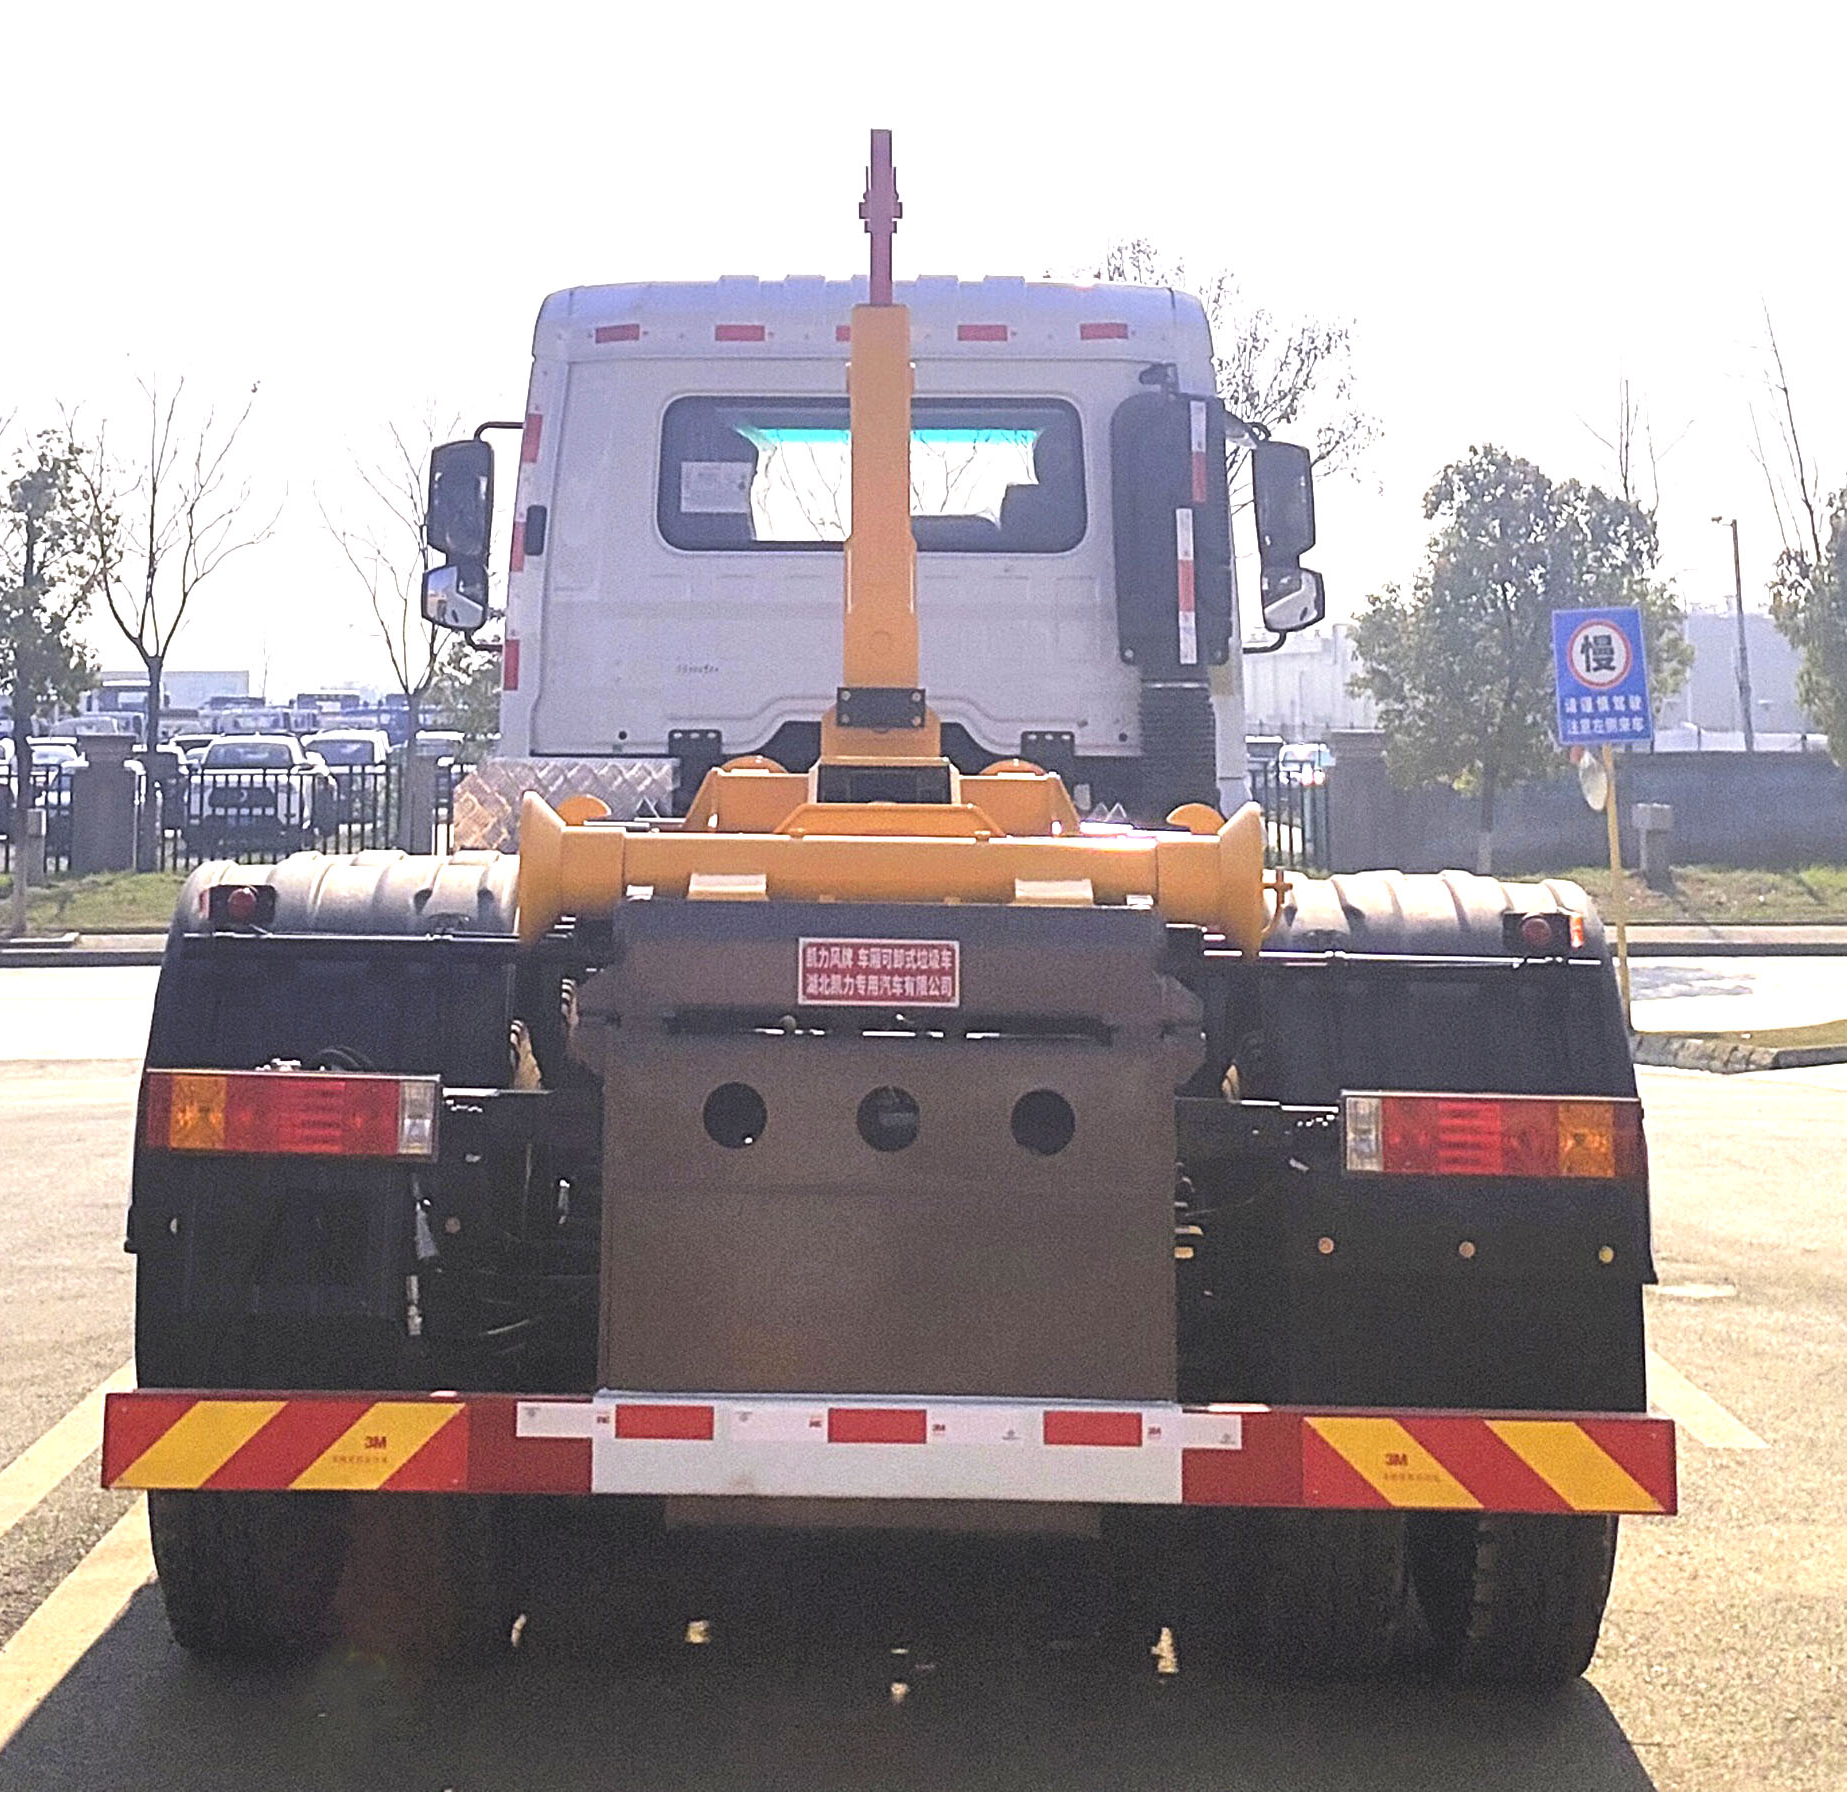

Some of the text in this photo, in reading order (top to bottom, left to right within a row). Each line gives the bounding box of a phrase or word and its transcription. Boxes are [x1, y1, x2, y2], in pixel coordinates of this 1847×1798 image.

[1580, 633, 1616, 673] 慢
[806, 973, 953, 997] 湖北凯力专用汽车有限公司
[364, 1435, 387, 1449] 3M
[1384, 1453, 1409, 1467] 3M
